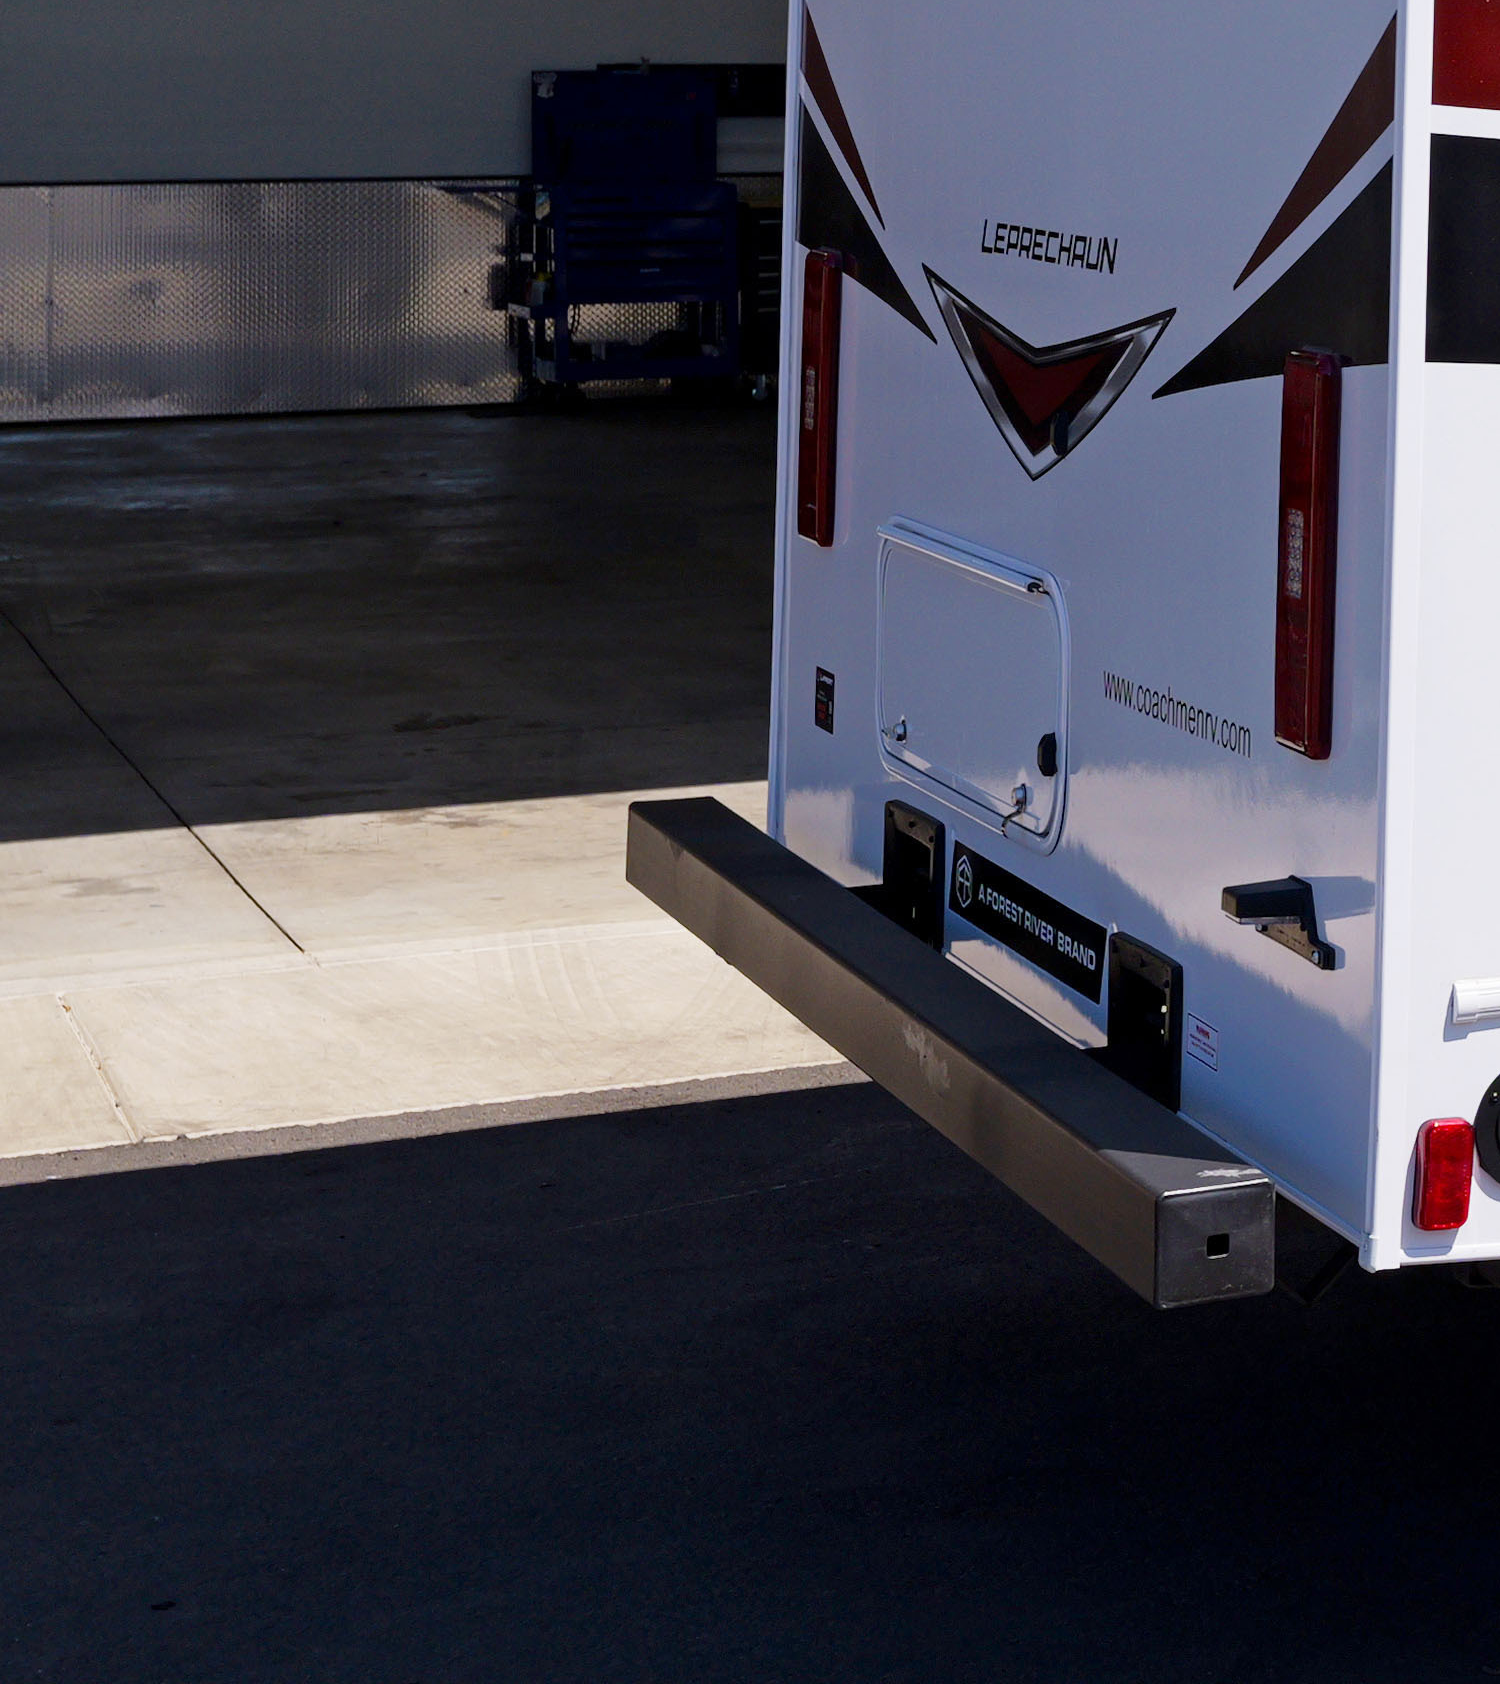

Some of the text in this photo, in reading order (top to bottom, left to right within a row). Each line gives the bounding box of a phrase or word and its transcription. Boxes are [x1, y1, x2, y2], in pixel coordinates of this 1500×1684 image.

[981, 218, 1119, 275] LEPRECHAUN
[1103, 670, 1251, 758] www.coachmenrv.com
[978, 883, 1097, 971] A FOREST RIVER BRAND
